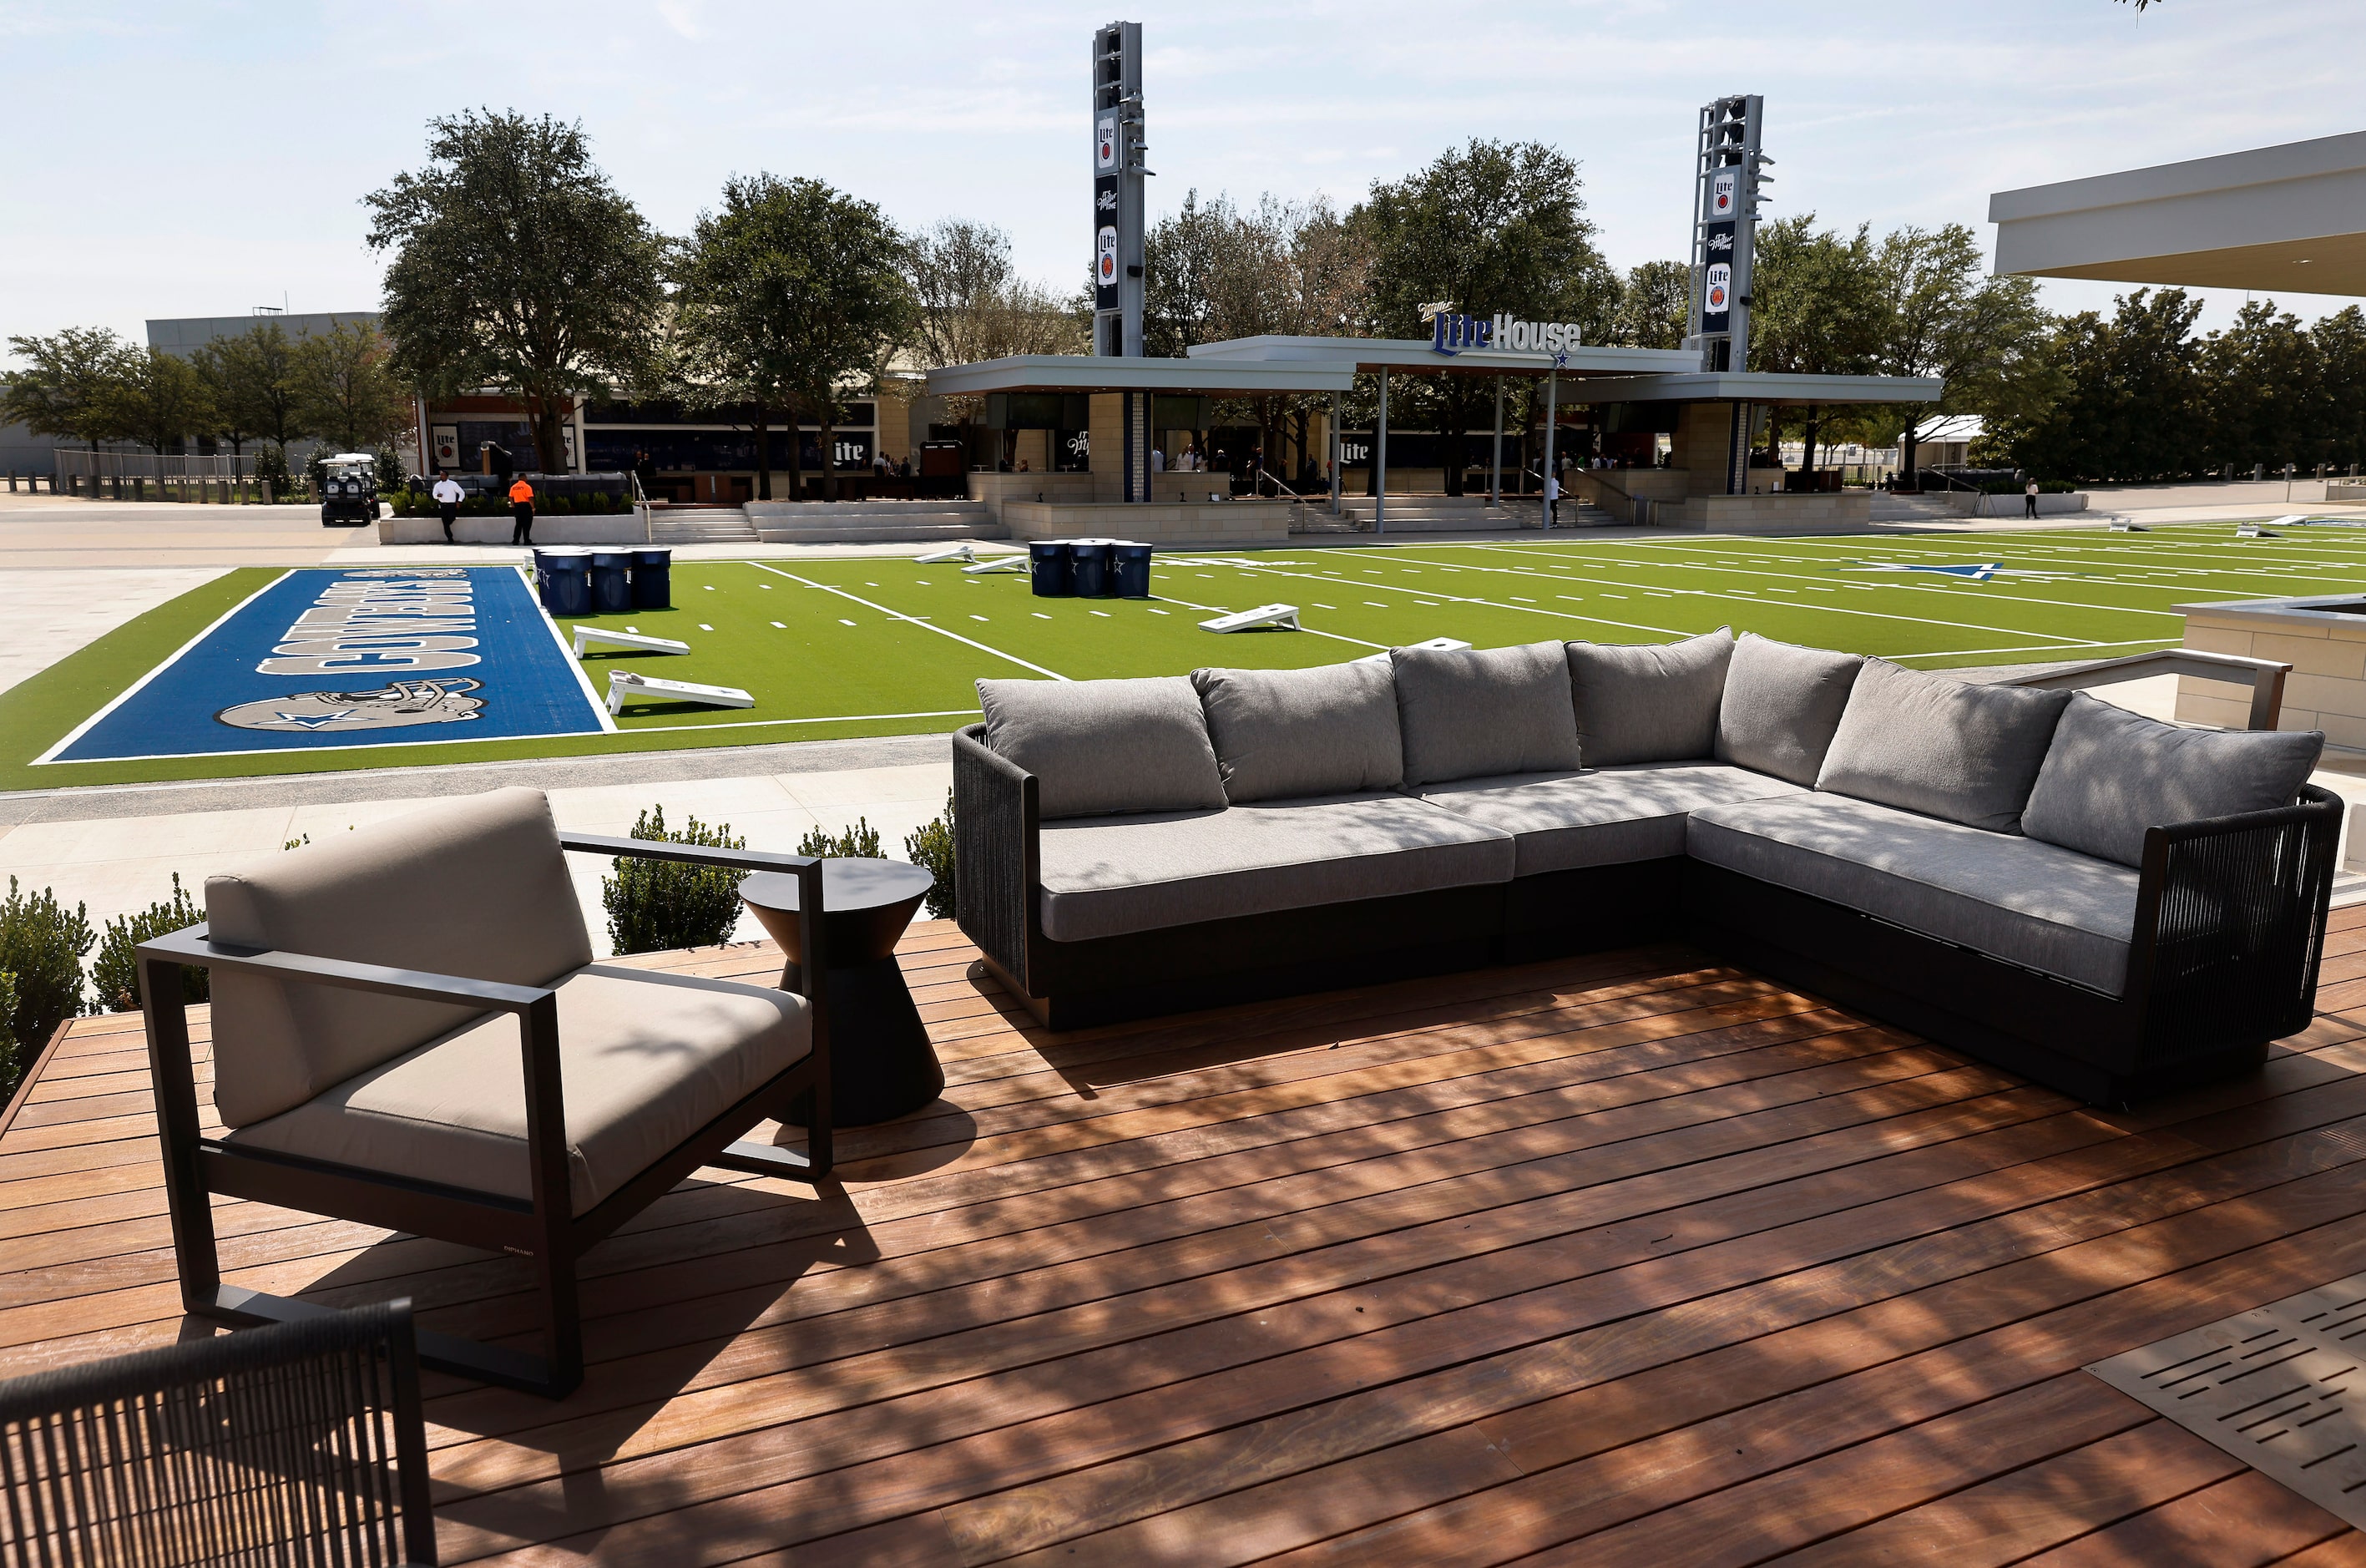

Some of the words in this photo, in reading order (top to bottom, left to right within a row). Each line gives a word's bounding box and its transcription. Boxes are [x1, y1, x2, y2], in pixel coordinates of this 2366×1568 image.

[1100, 128, 1114, 143] Lite
[1716, 182, 1733, 195] Lite
[1100, 235, 1115, 252] Lite
[1709, 271, 1728, 286] Lite
[1418, 301, 1453, 322] Miller
[437, 434, 455, 446] Lite
[833, 443, 863, 466] ite
[1339, 443, 1368, 464] Lite
[255, 579, 482, 675] COWBOYS
[504, 1246, 533, 1256] DIPHANO
